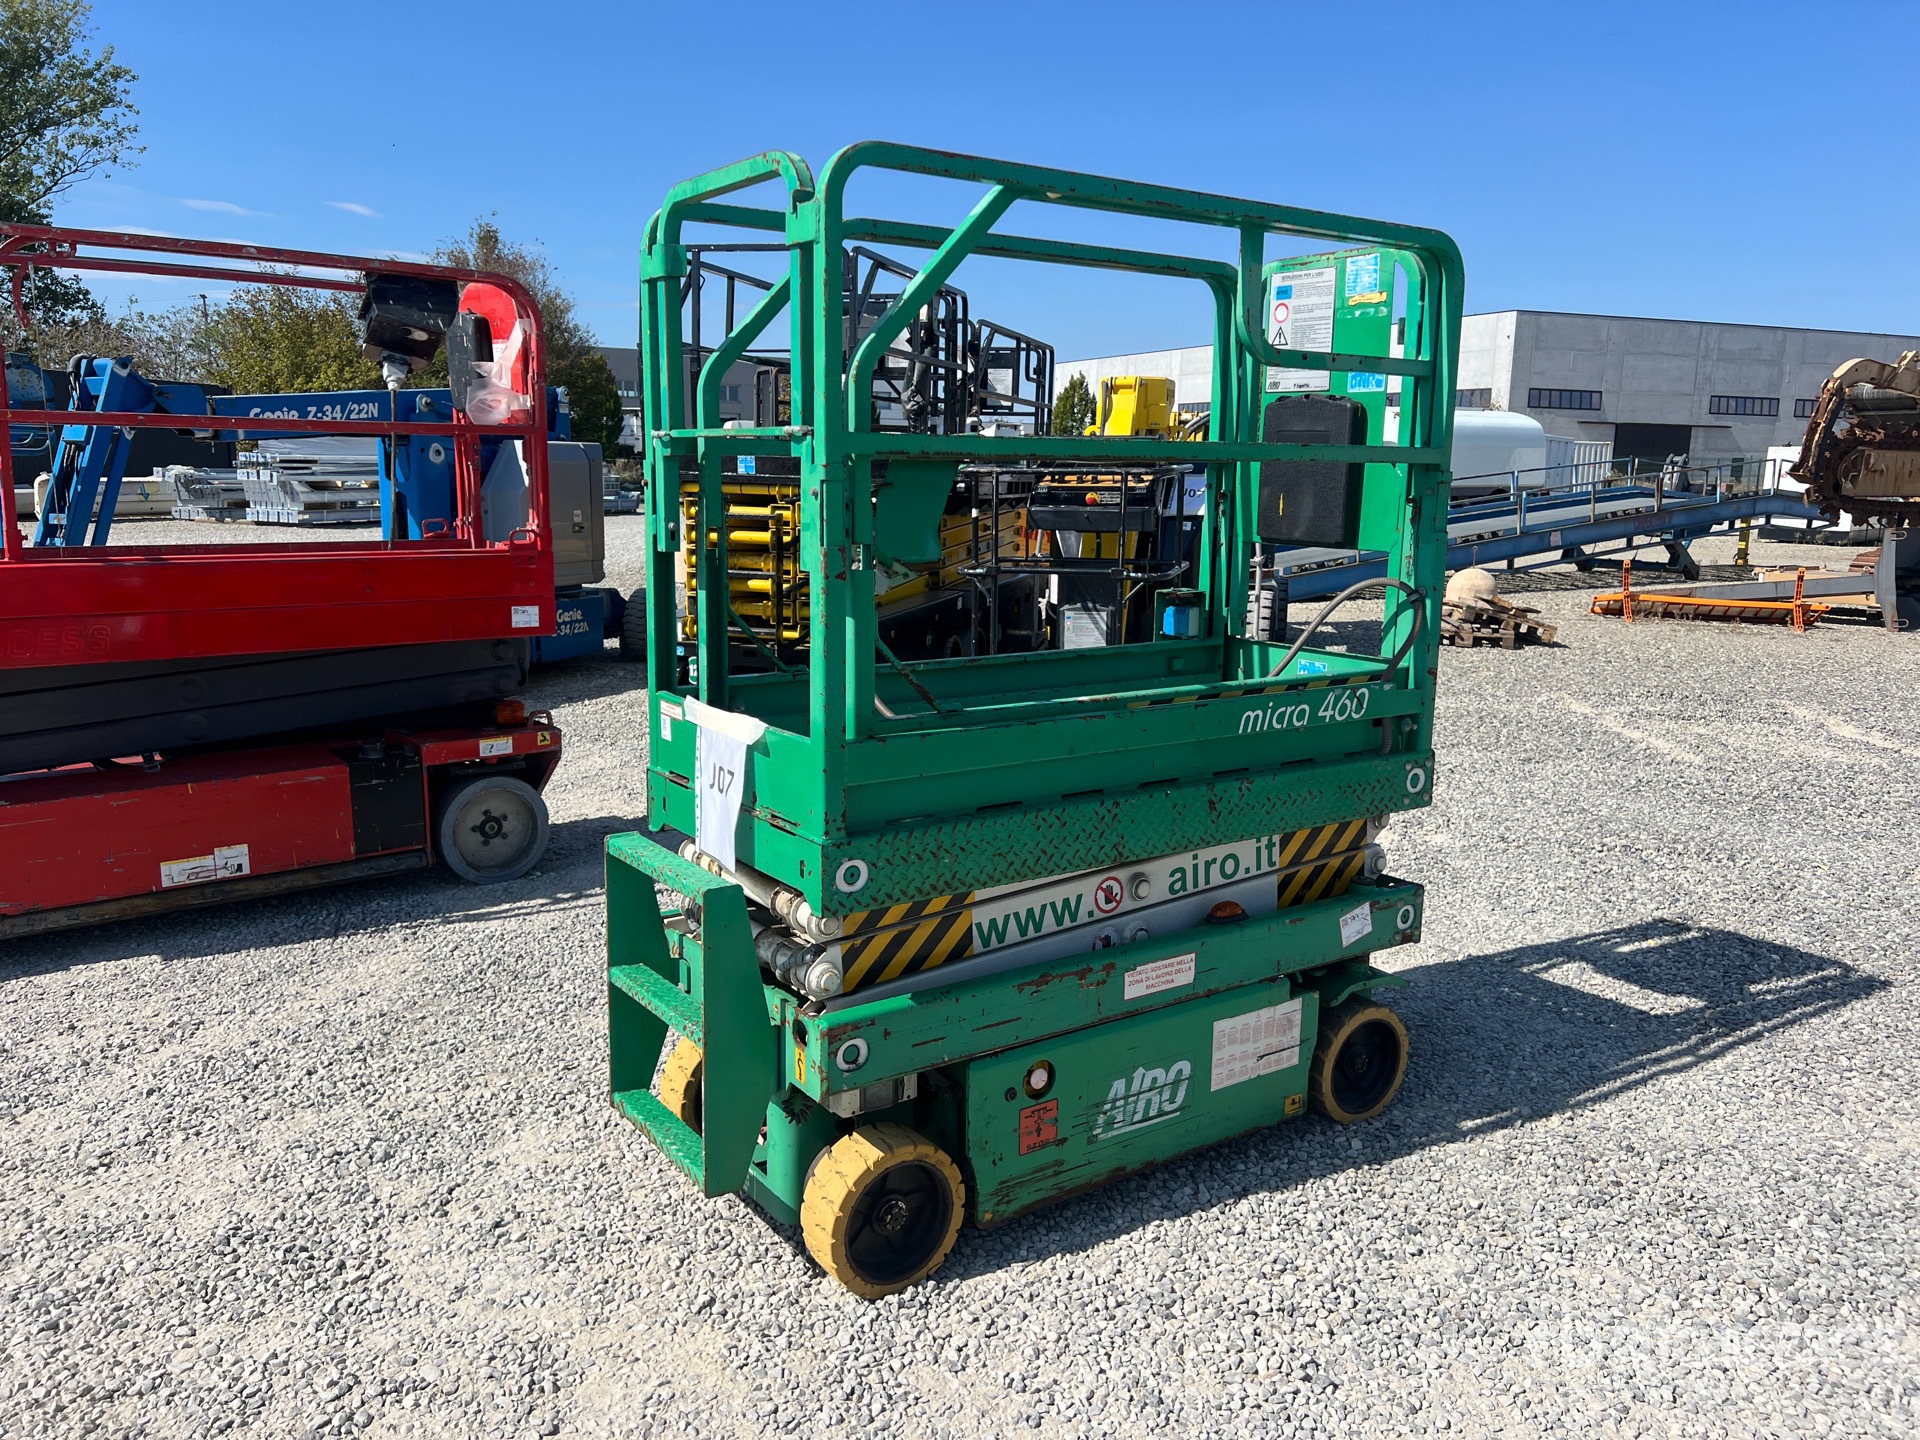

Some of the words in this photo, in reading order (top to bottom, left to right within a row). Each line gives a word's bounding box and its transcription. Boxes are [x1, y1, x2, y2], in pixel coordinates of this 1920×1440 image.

[307, 402, 379, 421] Z-34/22N
[556, 608, 583, 623] Genie
[556, 622, 589, 636] -34/22N
[1317, 688, 1369, 723] 460
[975, 893, 1095, 950] www.
[1168, 836, 1277, 896] airo.it
[1126, 968, 1149, 978] VIETATO
[1150, 961, 1175, 973] SOSTARE
[1176, 957, 1193, 967] NELLA
[1128, 978, 1144, 987] ZONA
[1151, 970, 1173, 981] LAVORO
[1174, 965, 1192, 975] DELLA
[1145, 978, 1175, 990] MACCHINA
[1092, 1060, 1191, 1137] AIRO
